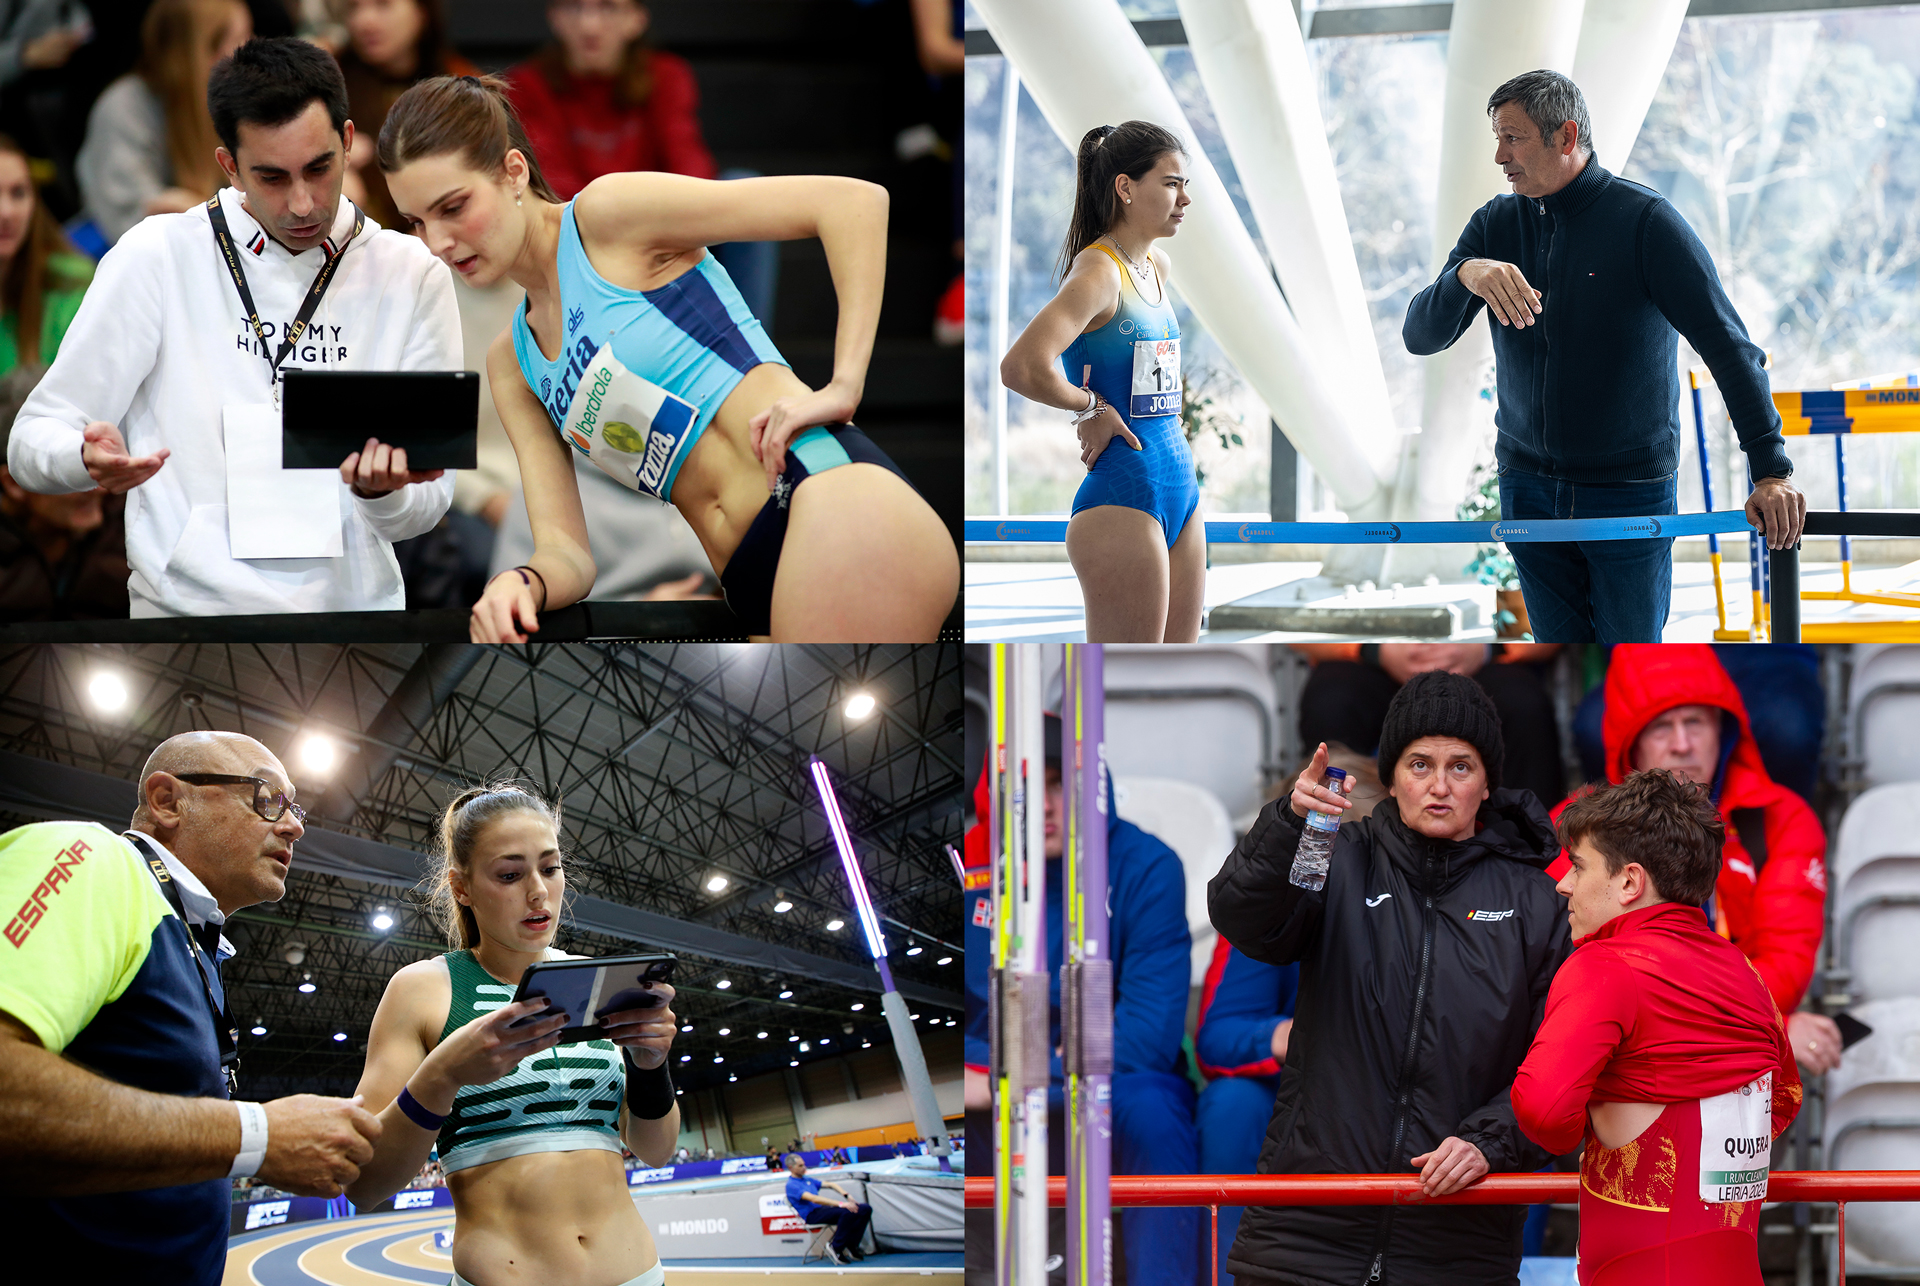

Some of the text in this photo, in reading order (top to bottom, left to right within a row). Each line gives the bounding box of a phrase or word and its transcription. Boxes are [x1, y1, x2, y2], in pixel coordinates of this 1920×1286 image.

[575, 366, 613, 438] Iberdrola
[1149, 394, 1180, 413] Joma
[2, 839, 93, 949] ESPAÑA
[1472, 909, 1514, 921] ESP
[1729, 1171, 1745, 1183] RUN
[1748, 1182, 1766, 1199] 2024
[670, 1218, 729, 1236] MONDO
